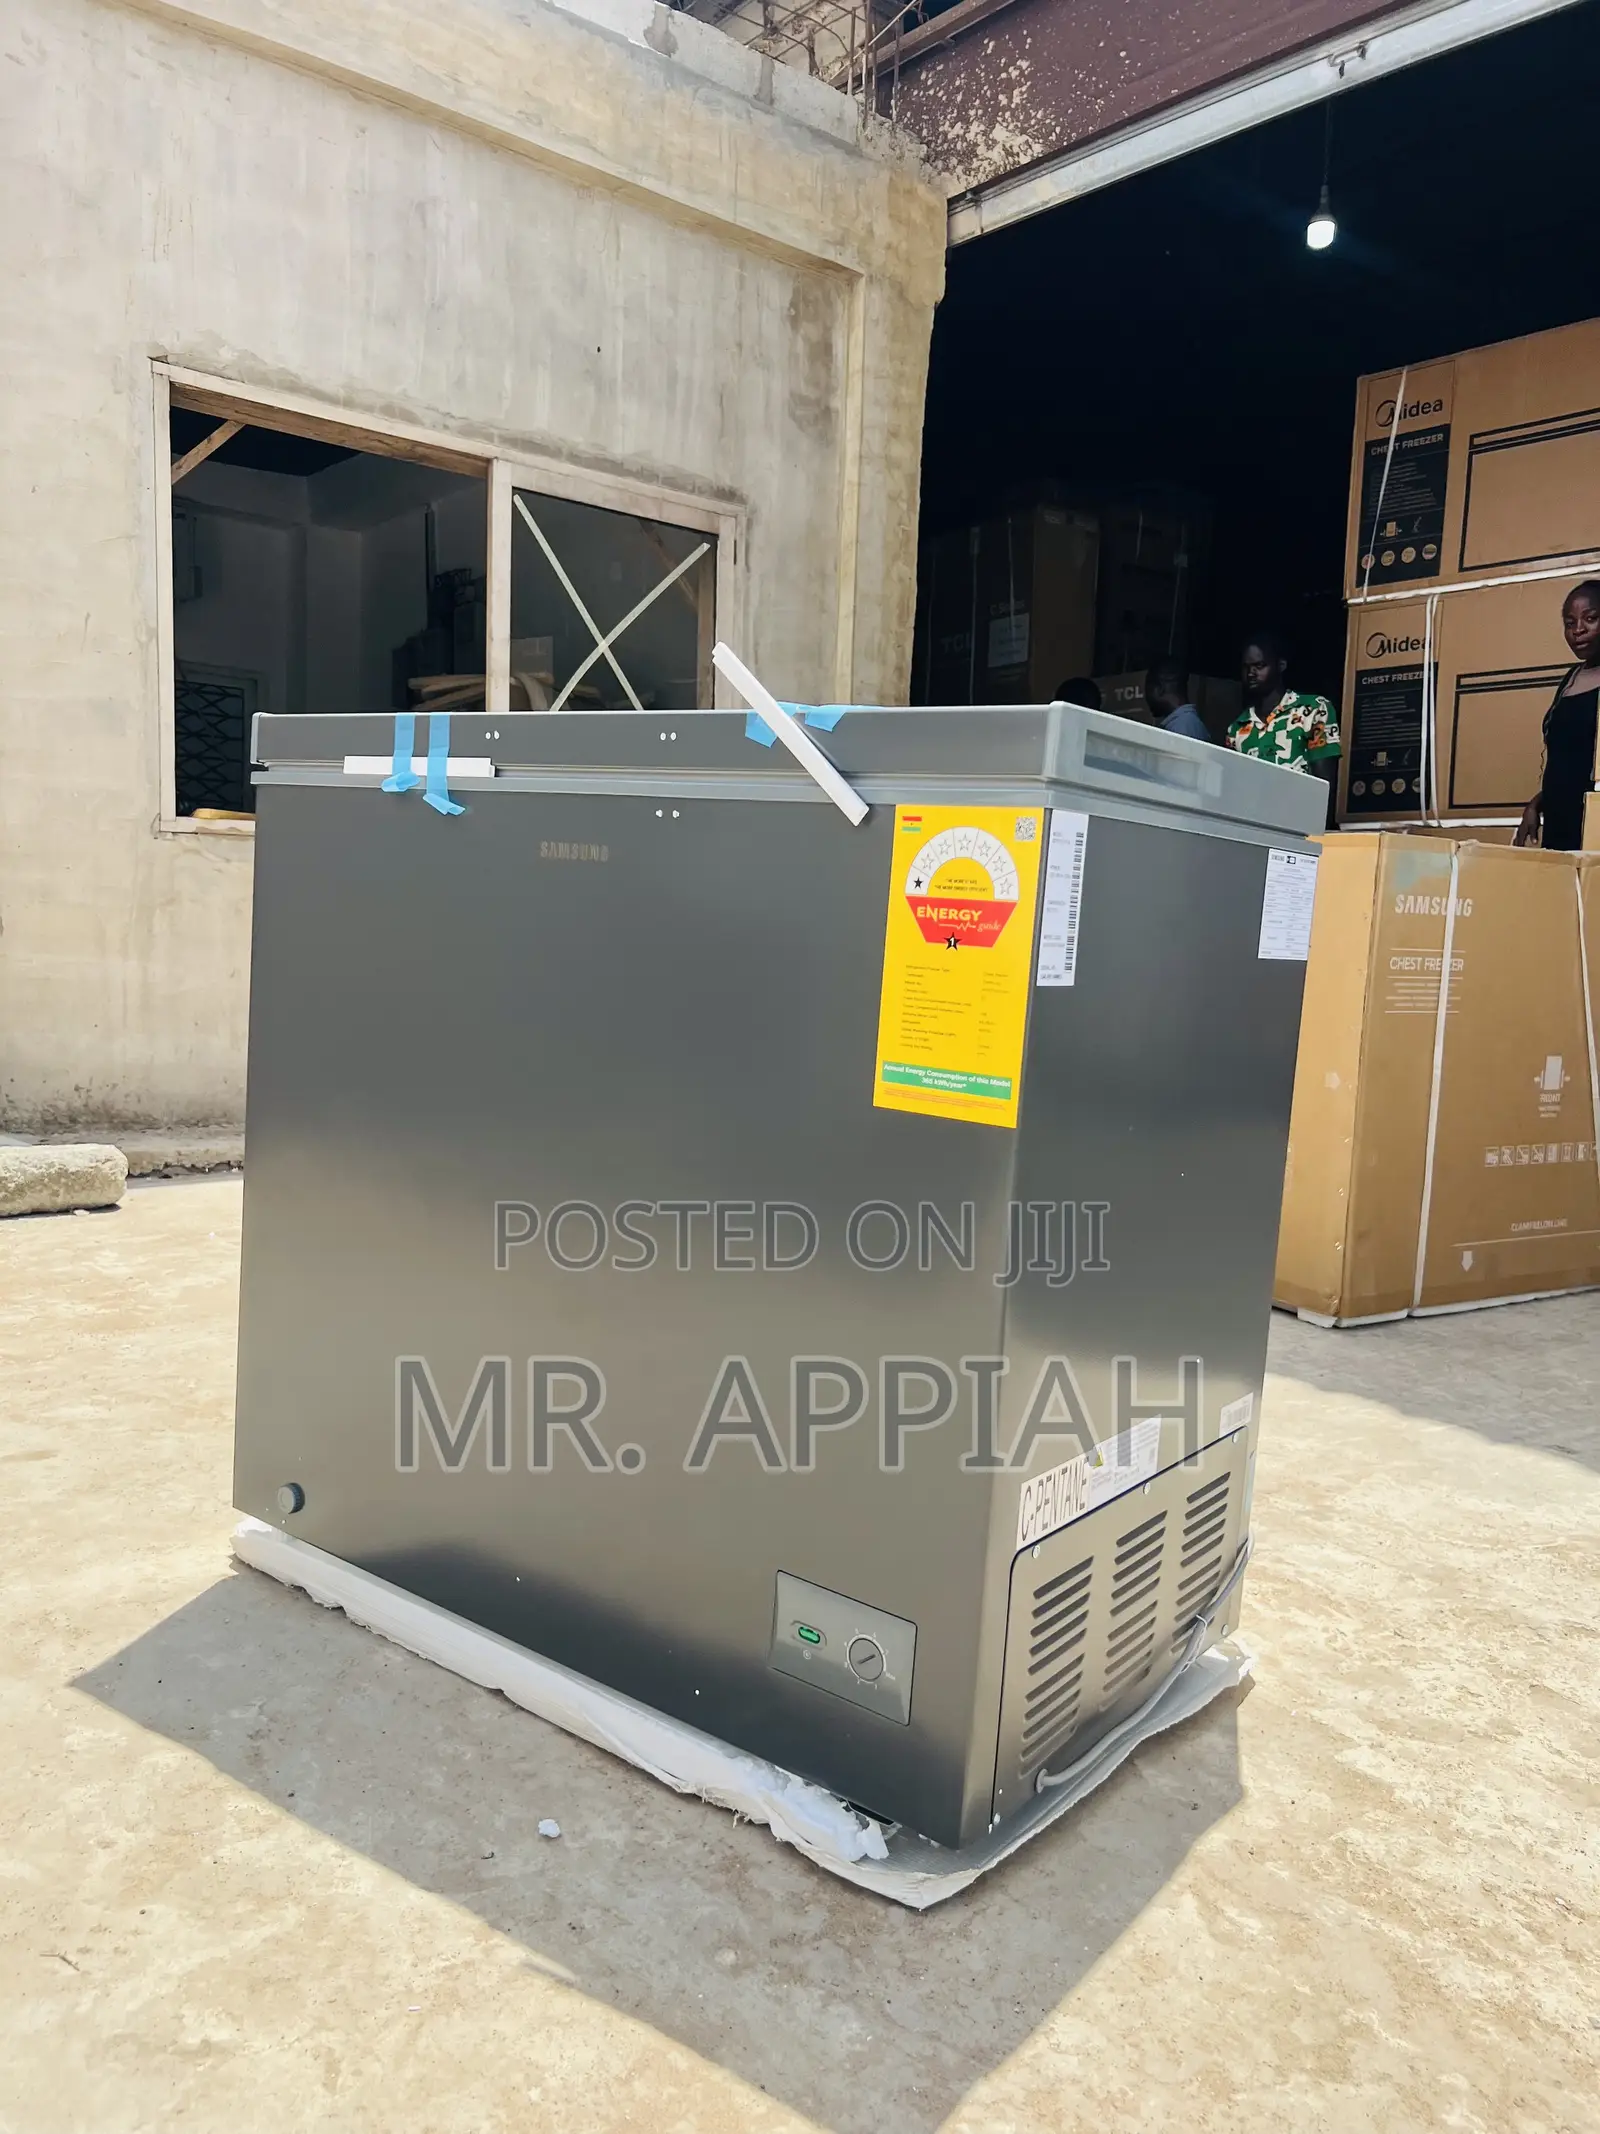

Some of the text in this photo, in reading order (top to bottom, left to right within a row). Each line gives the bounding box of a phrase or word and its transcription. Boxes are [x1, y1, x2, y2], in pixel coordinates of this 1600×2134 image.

[1376, 399, 1443, 427] Midea
[1371, 433, 1444, 456] CHET FREEZER
[1362, 673, 1389, 685] CHEST
[1114, 686, 1144, 701] TCL
[540, 841, 609, 863] SAMSUNG
[917, 904, 982, 922] ENERGY
[949, 937, 955, 947] 1
[1390, 957, 1422, 970] CHEST
[905, 1066, 925, 1077] Energy
[927, 1070, 968, 1081] Consumption
[990, 1078, 1011, 1088] Model
[1021, 1455, 1089, 1542] C-PENTANE
